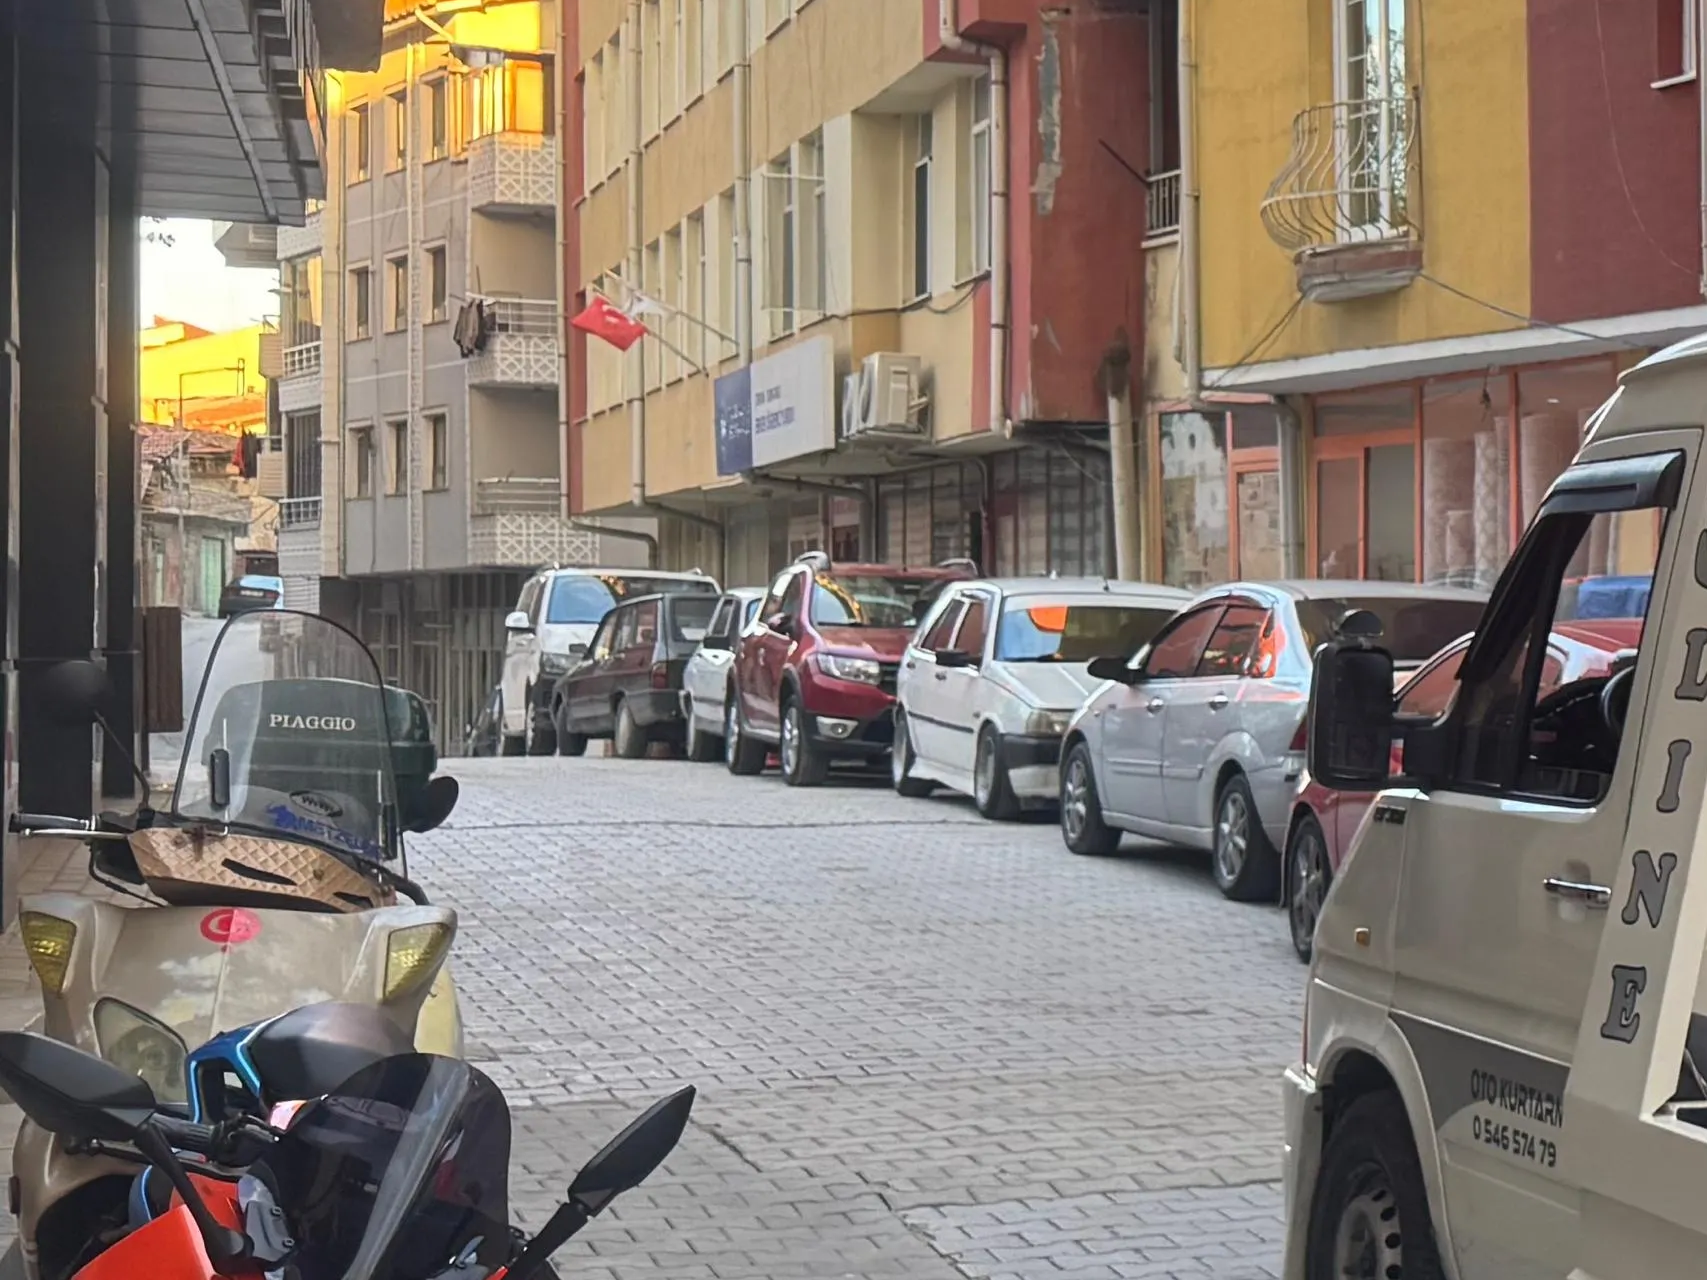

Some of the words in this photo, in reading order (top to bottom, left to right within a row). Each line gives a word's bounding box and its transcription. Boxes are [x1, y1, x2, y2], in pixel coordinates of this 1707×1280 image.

[268, 713, 357, 732] PIAGGIO
[1471, 1068, 1497, 1105] OTO
[1473, 1114, 1482, 1140] 0
[1484, 1118, 1509, 1151] 546
[1512, 1128, 1536, 1160] 574
